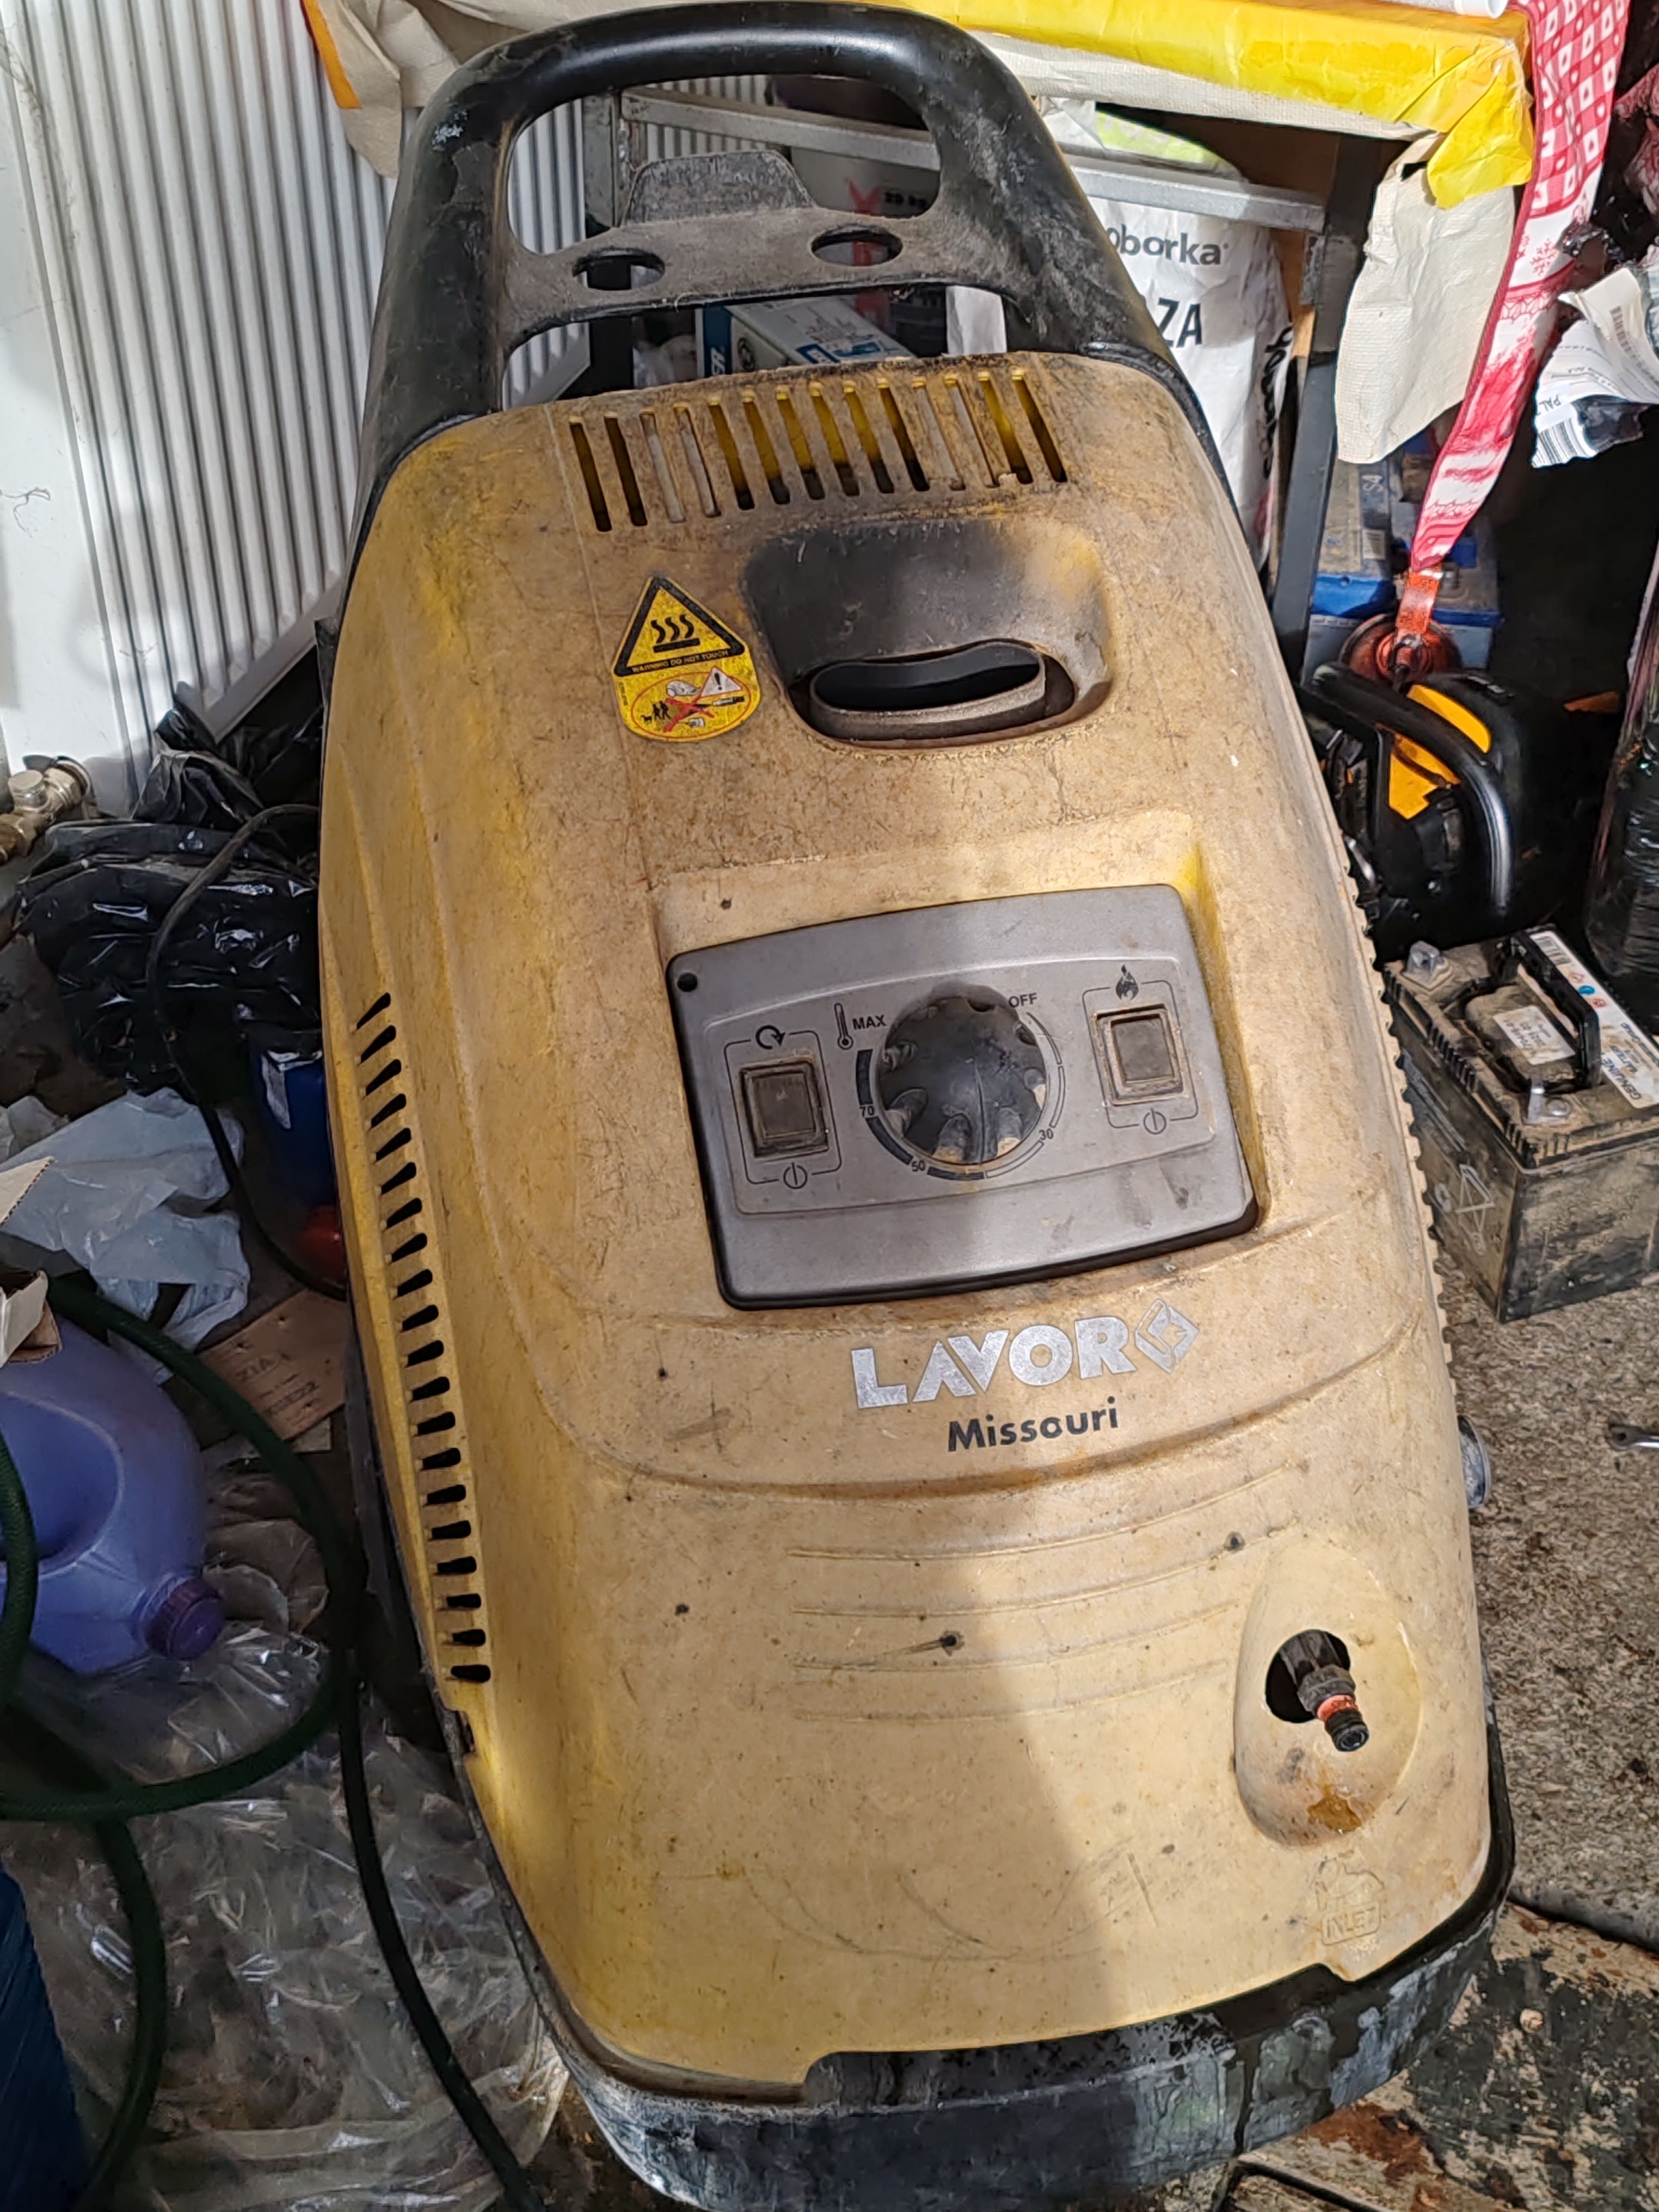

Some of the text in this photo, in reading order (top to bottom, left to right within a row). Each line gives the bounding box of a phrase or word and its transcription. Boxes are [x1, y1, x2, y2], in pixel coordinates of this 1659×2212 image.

[670, 658, 683, 666] DO
[684, 655, 701, 664] NOT
[701, 650, 729, 660] TOUCH
[1009, 992, 1037, 1008] OFF
[852, 1014, 887, 1030] MAX
[859, 1105, 875, 1118] 70
[1039, 1128, 1054, 1141] 30
[911, 1159, 926, 1172] 50
[851, 1316, 1138, 1410] LAVOR
[948, 1396, 1119, 1453] Missouri
[1325, 1906, 1377, 1939] INLET
